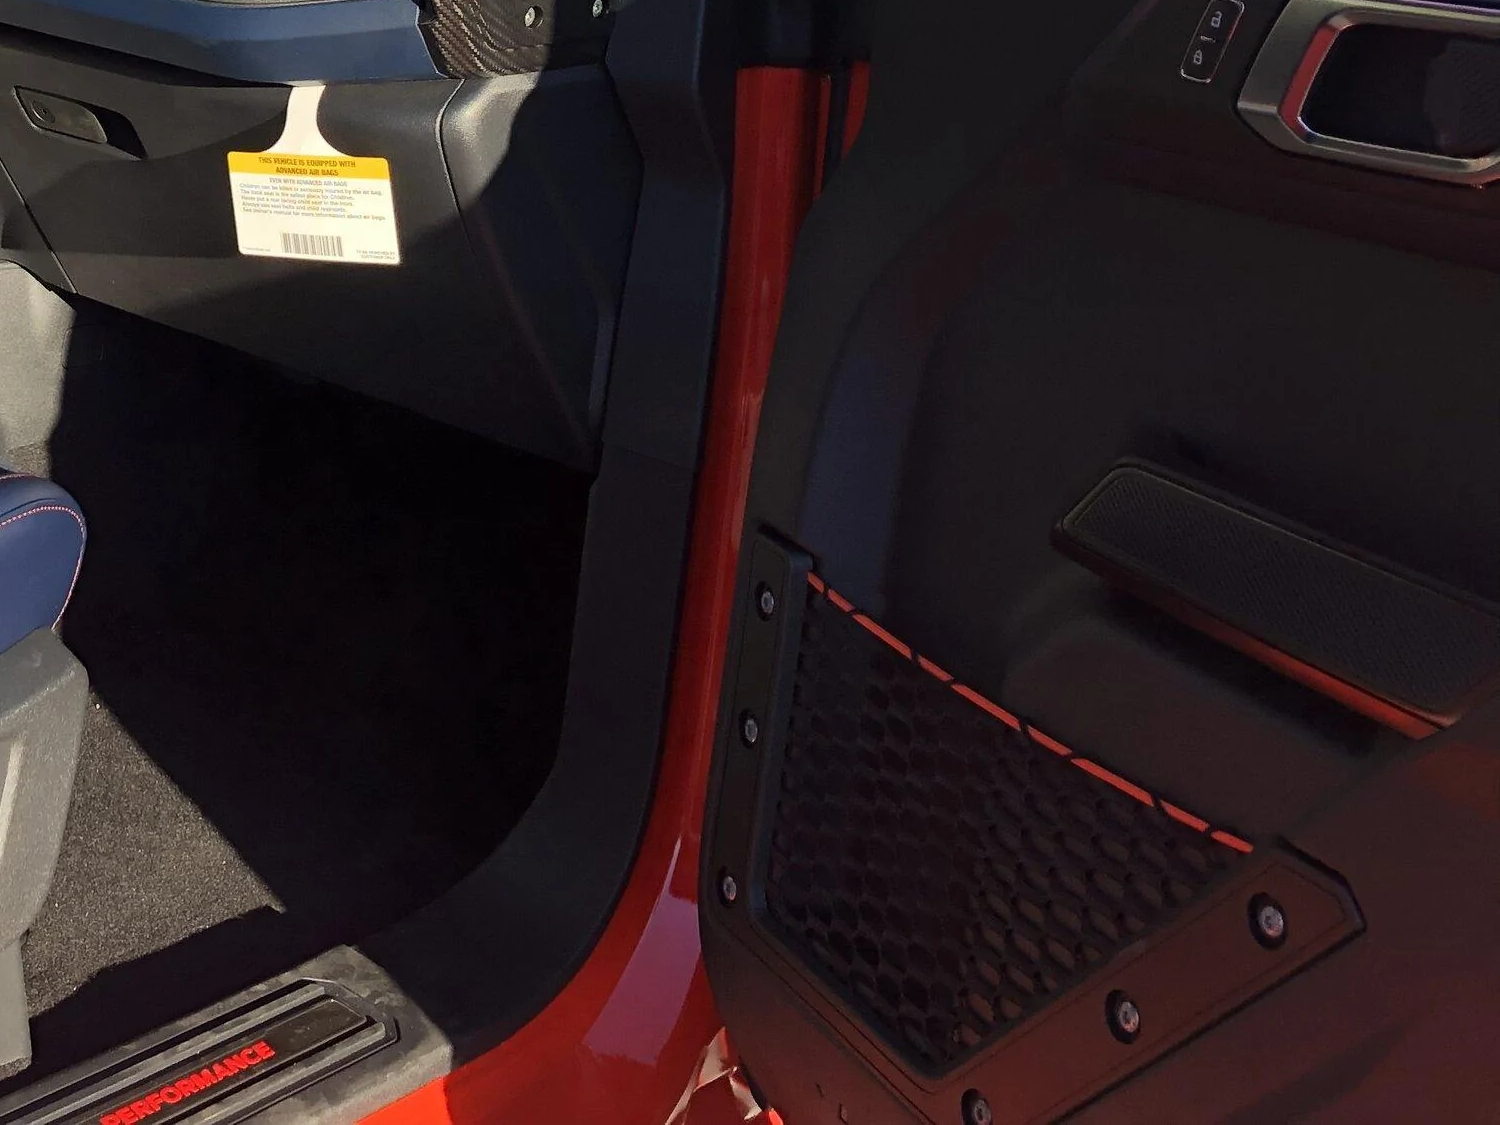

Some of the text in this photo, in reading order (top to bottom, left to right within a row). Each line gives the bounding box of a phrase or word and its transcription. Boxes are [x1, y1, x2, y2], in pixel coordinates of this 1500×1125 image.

[258, 156, 272, 164] THIS
[273, 158, 297, 166] VEHICLE
[306, 159, 337, 168] EQUIPPED
[338, 160, 356, 168] WITH
[276, 166, 308, 175] ADVANCED
[309, 168, 320, 176] AIR
[99, 1041, 276, 1125] PERFORMANCE
